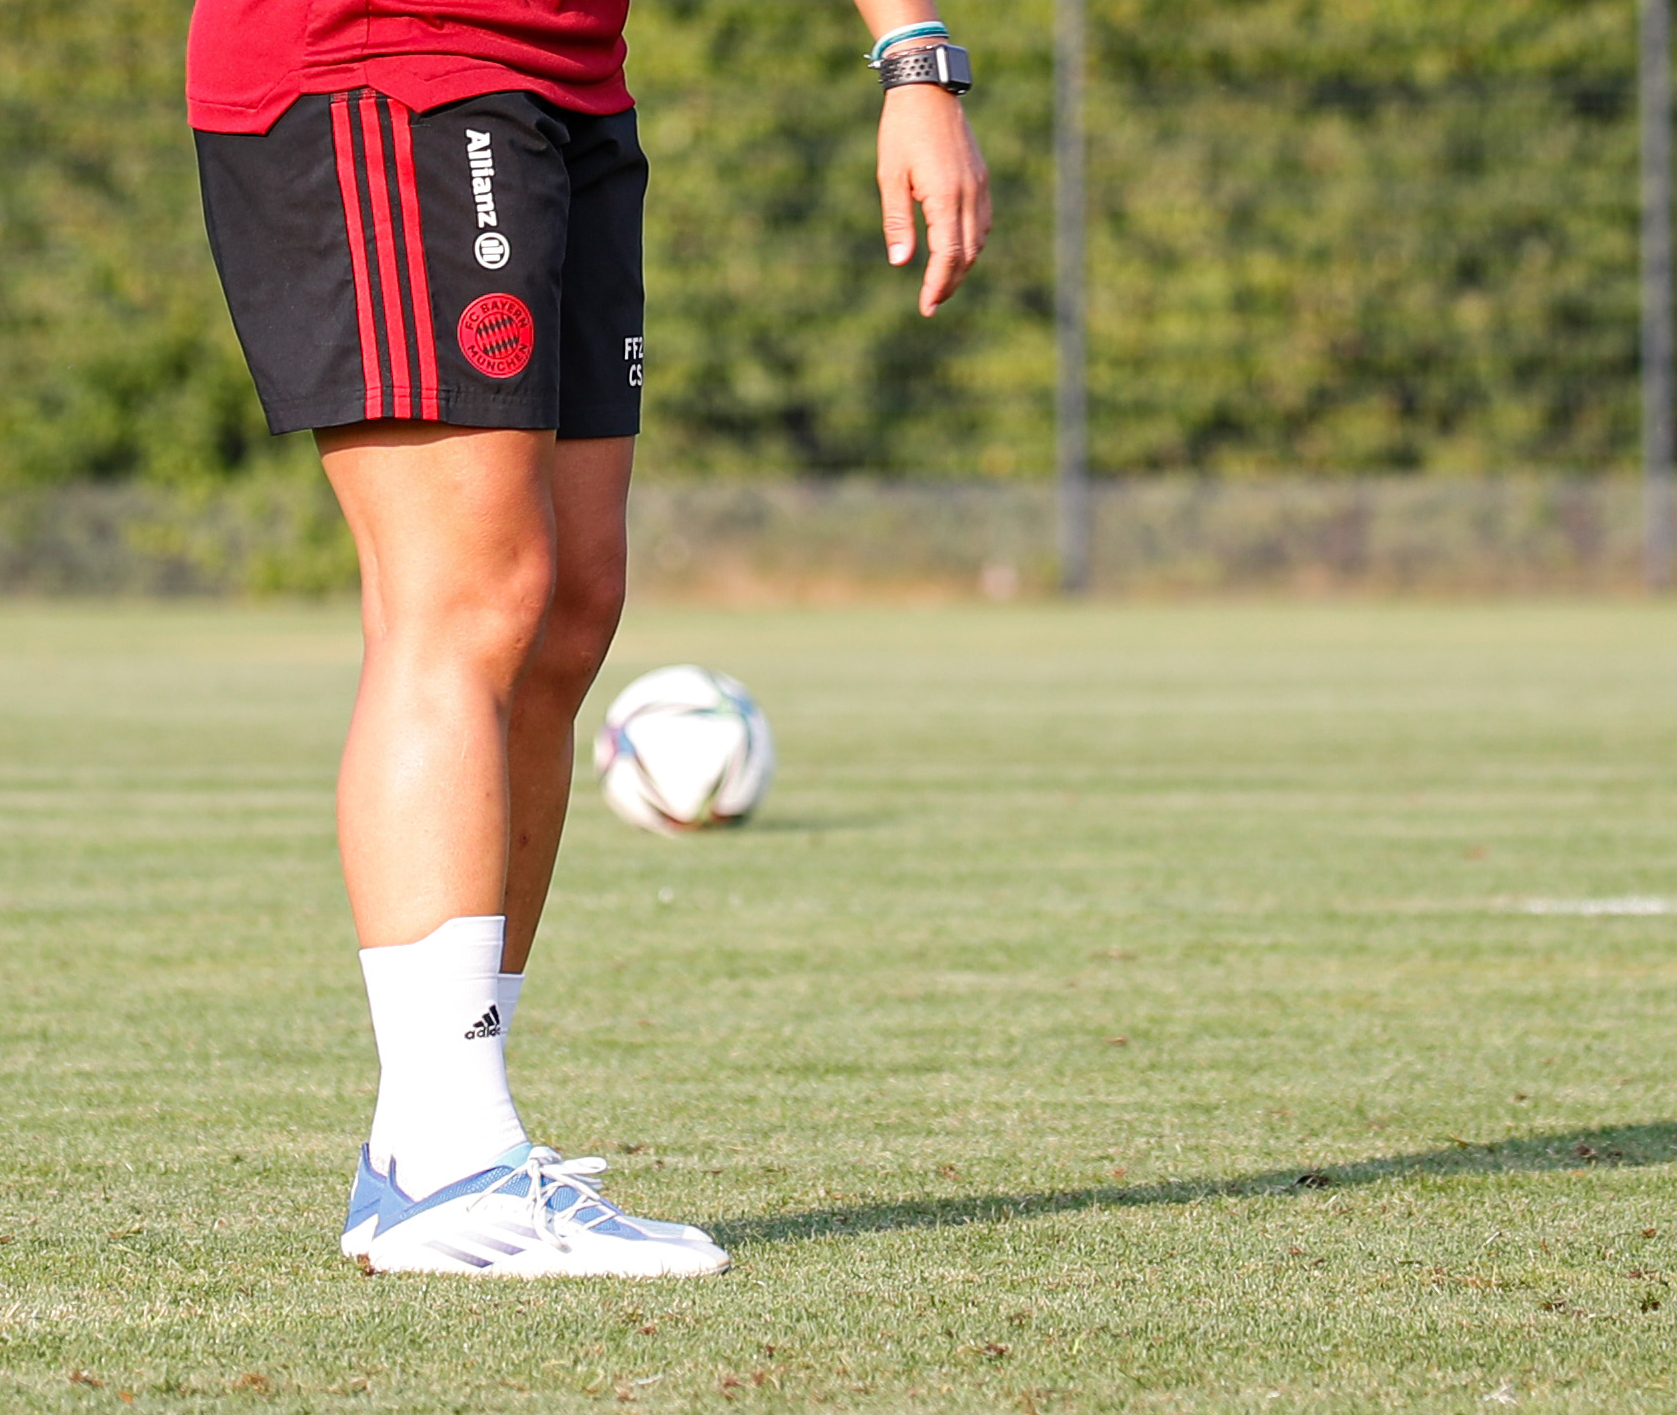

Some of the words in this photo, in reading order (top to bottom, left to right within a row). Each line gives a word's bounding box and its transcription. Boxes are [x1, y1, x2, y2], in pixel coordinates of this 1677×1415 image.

[466, 129, 498, 228] Allianz
[465, 311, 480, 331] FC
[480, 300, 528, 328] BAYERN
